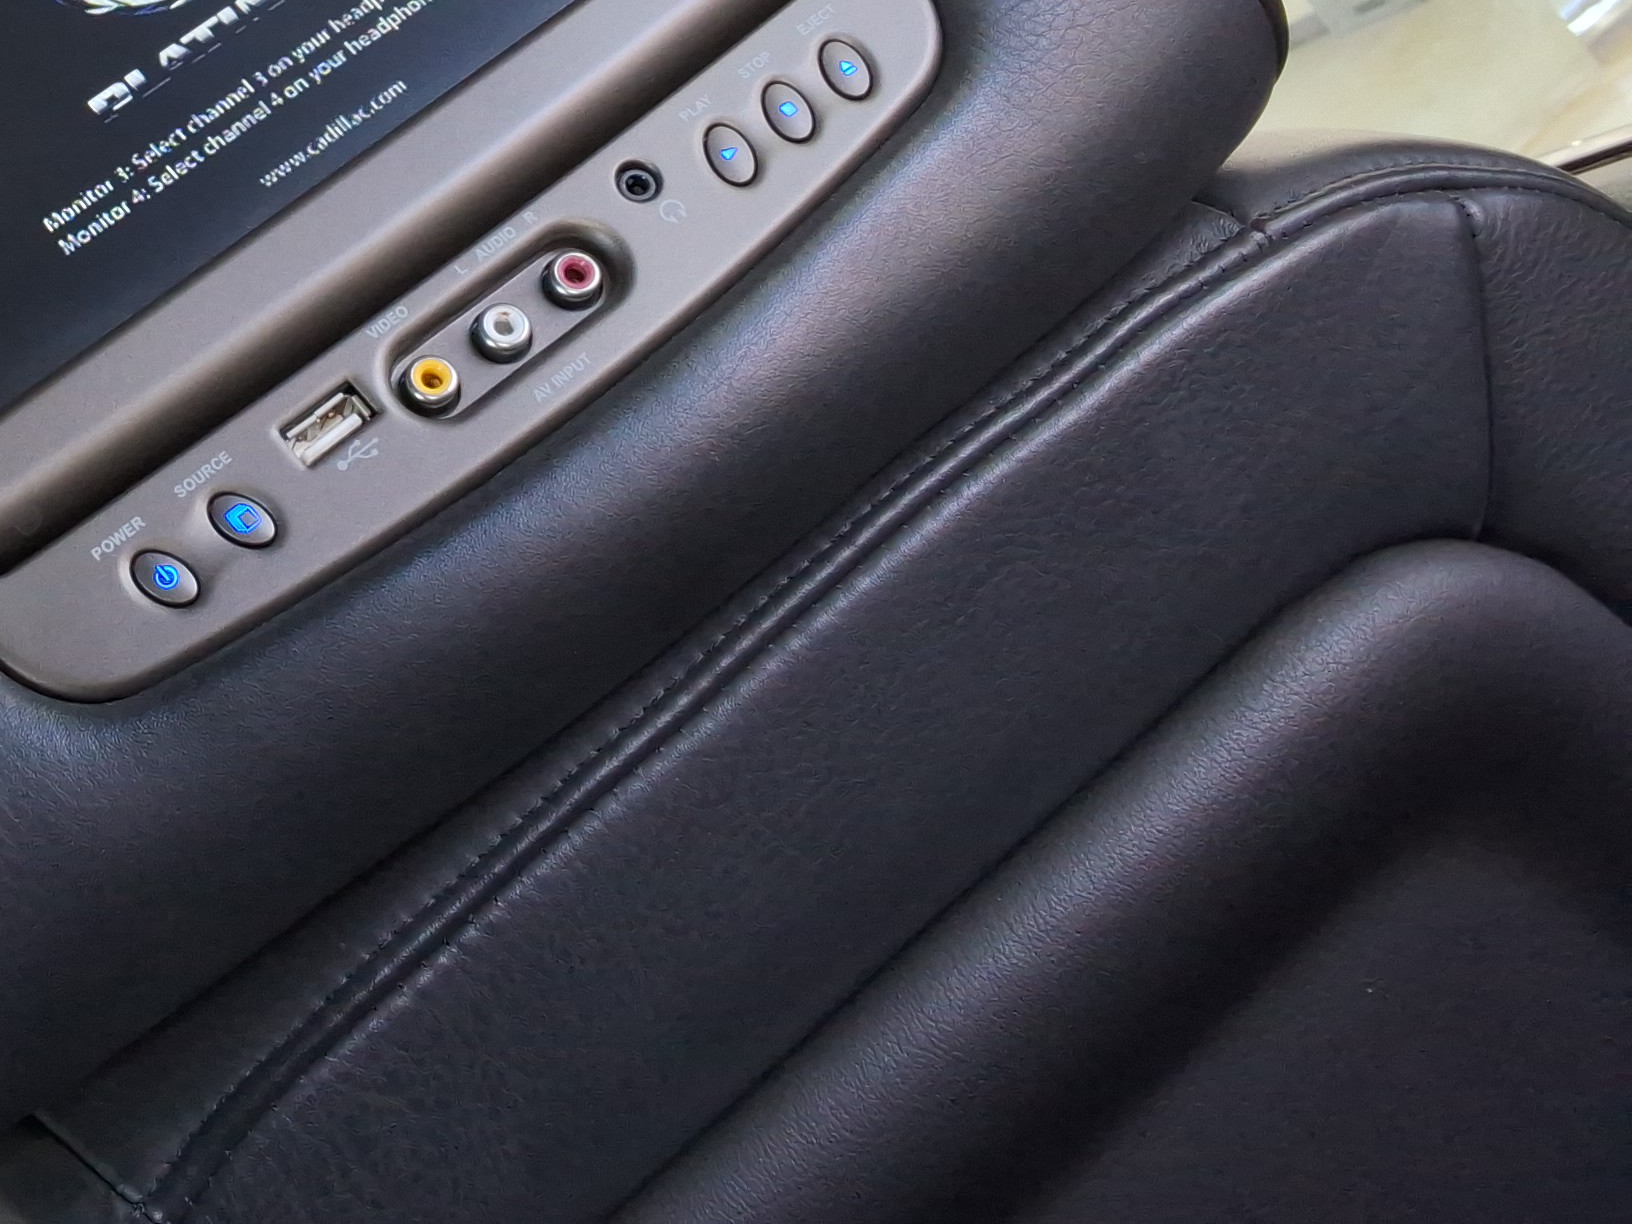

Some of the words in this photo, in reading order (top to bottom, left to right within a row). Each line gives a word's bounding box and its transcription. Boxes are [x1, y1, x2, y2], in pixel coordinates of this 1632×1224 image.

[796, 2, 837, 37] EJECT
[737, 50, 771, 80] STOP
[42, 179, 114, 233] Monitor
[114, 166, 135, 183] 3:
[131, 127, 188, 171] Select
[187, 78, 256, 134] channel
[253, 71, 268, 86] 3
[268, 56, 294, 77] on
[292, 27, 331, 63] your
[677, 94, 714, 123] PLAY
[57, 200, 131, 256] Monitor
[131, 188, 151, 204] 4:
[147, 149, 205, 193] Select
[203, 100, 272, 155] channel
[270, 92, 284, 107] 4
[284, 77, 310, 99] on
[308, 50, 347, 85] your
[259, 80, 408, 188] www.cadillac.com
[454, 264, 468, 276] L
[474, 226, 517, 261] AUDIO
[523, 210, 539, 225] R
[366, 305, 409, 339] VIDEO
[532, 381, 553, 403] AV
[552, 351, 592, 389] INPUT
[174, 451, 233, 498] SOURCE
[91, 516, 146, 561] POWER
